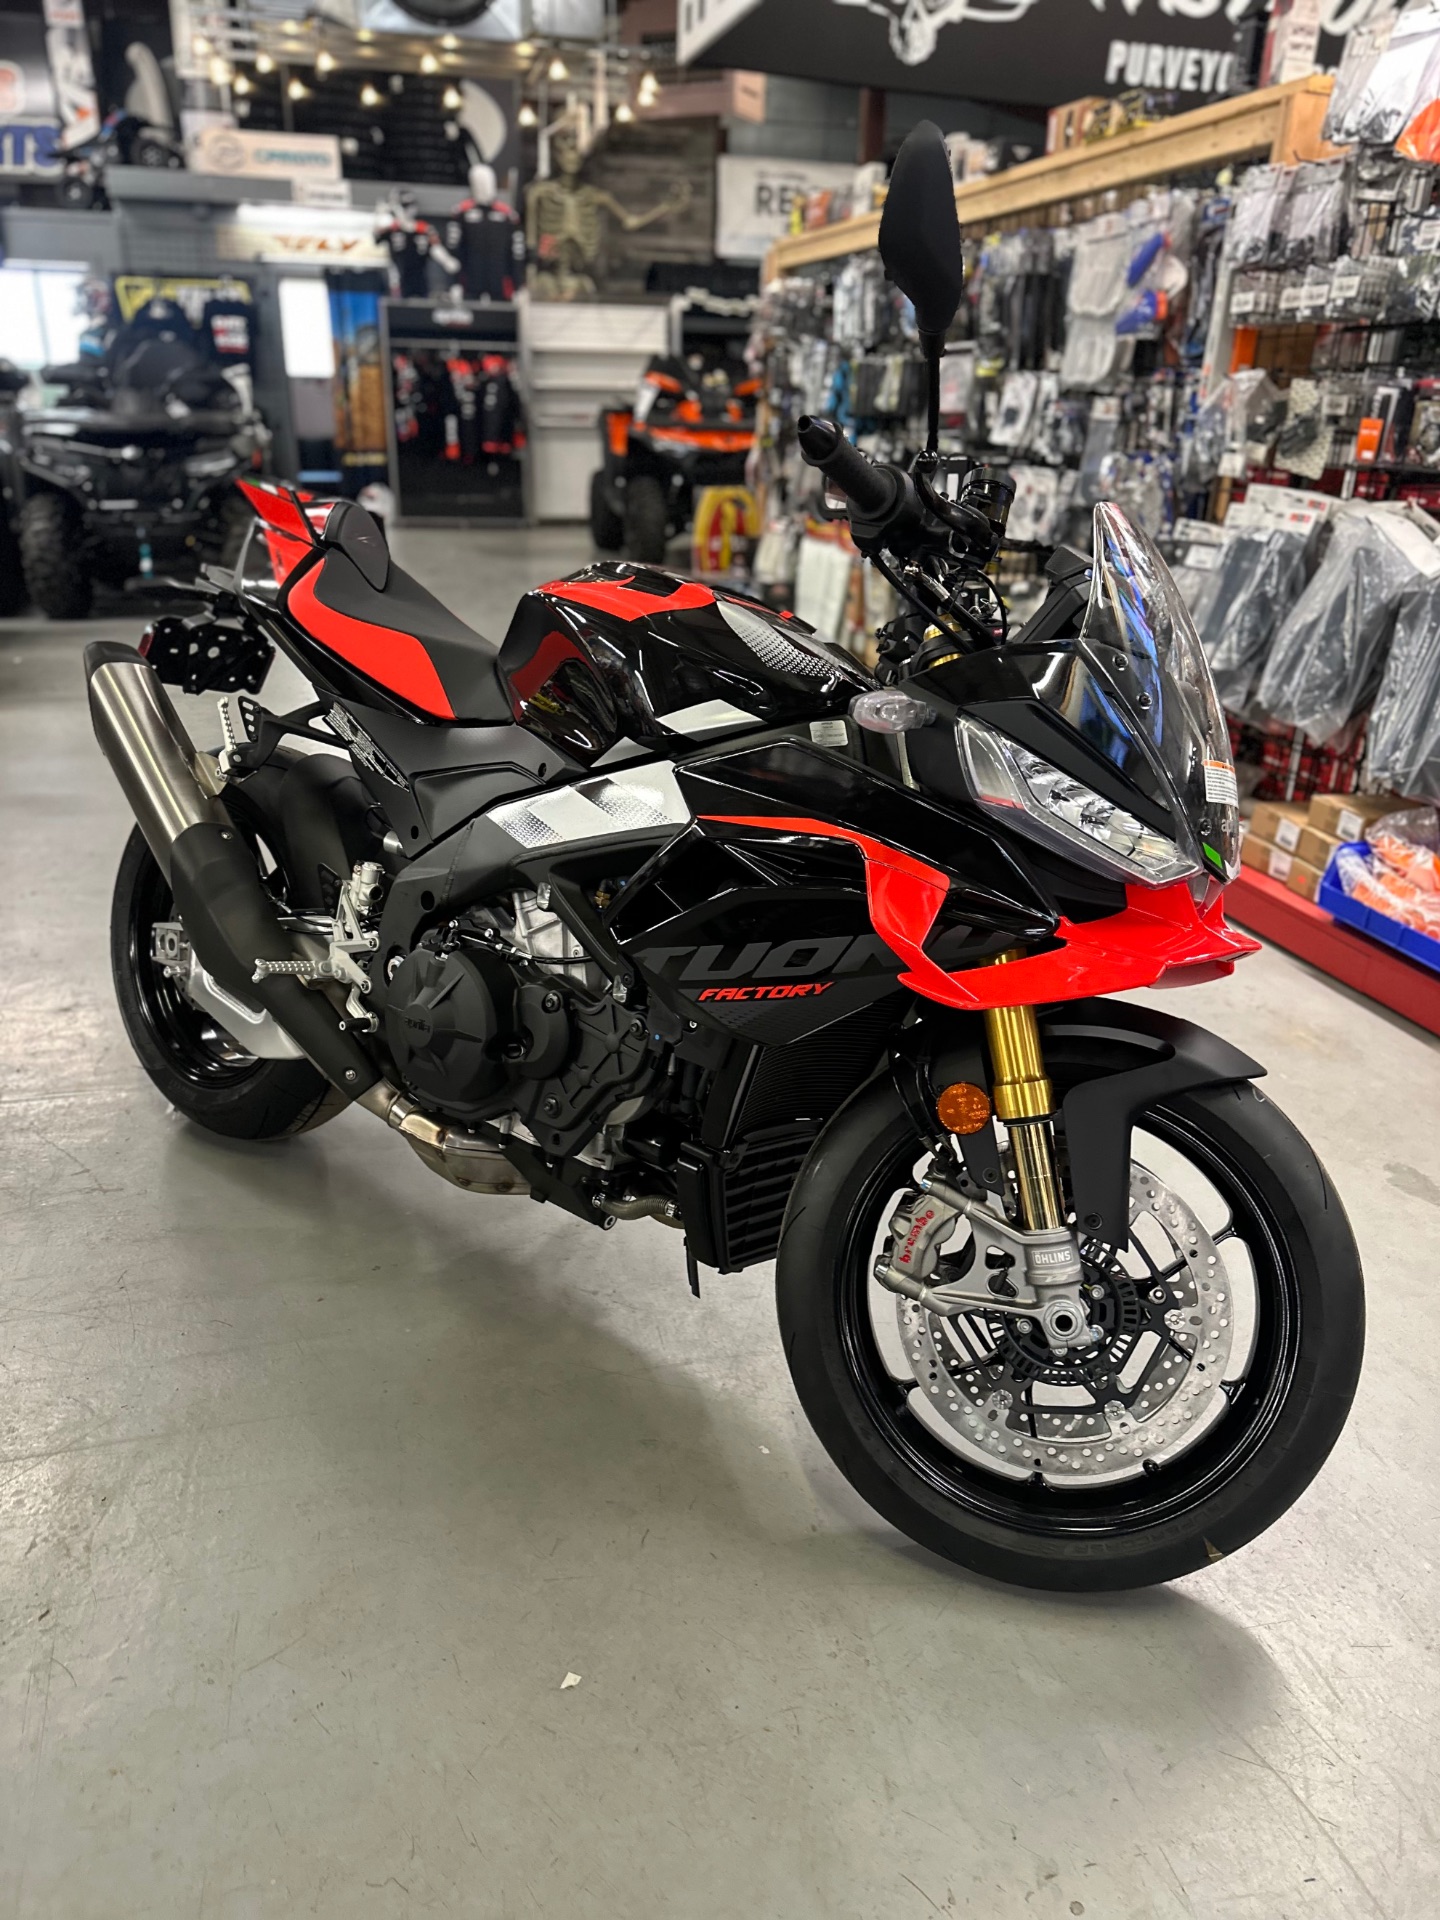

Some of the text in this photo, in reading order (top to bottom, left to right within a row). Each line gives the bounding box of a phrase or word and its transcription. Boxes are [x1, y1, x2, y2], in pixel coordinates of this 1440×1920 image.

[697, 981, 836, 1001] FACTORY
[898, 1210, 935, 1263] brembo
[1033, 1250, 1071, 1265] ÖHLINS
